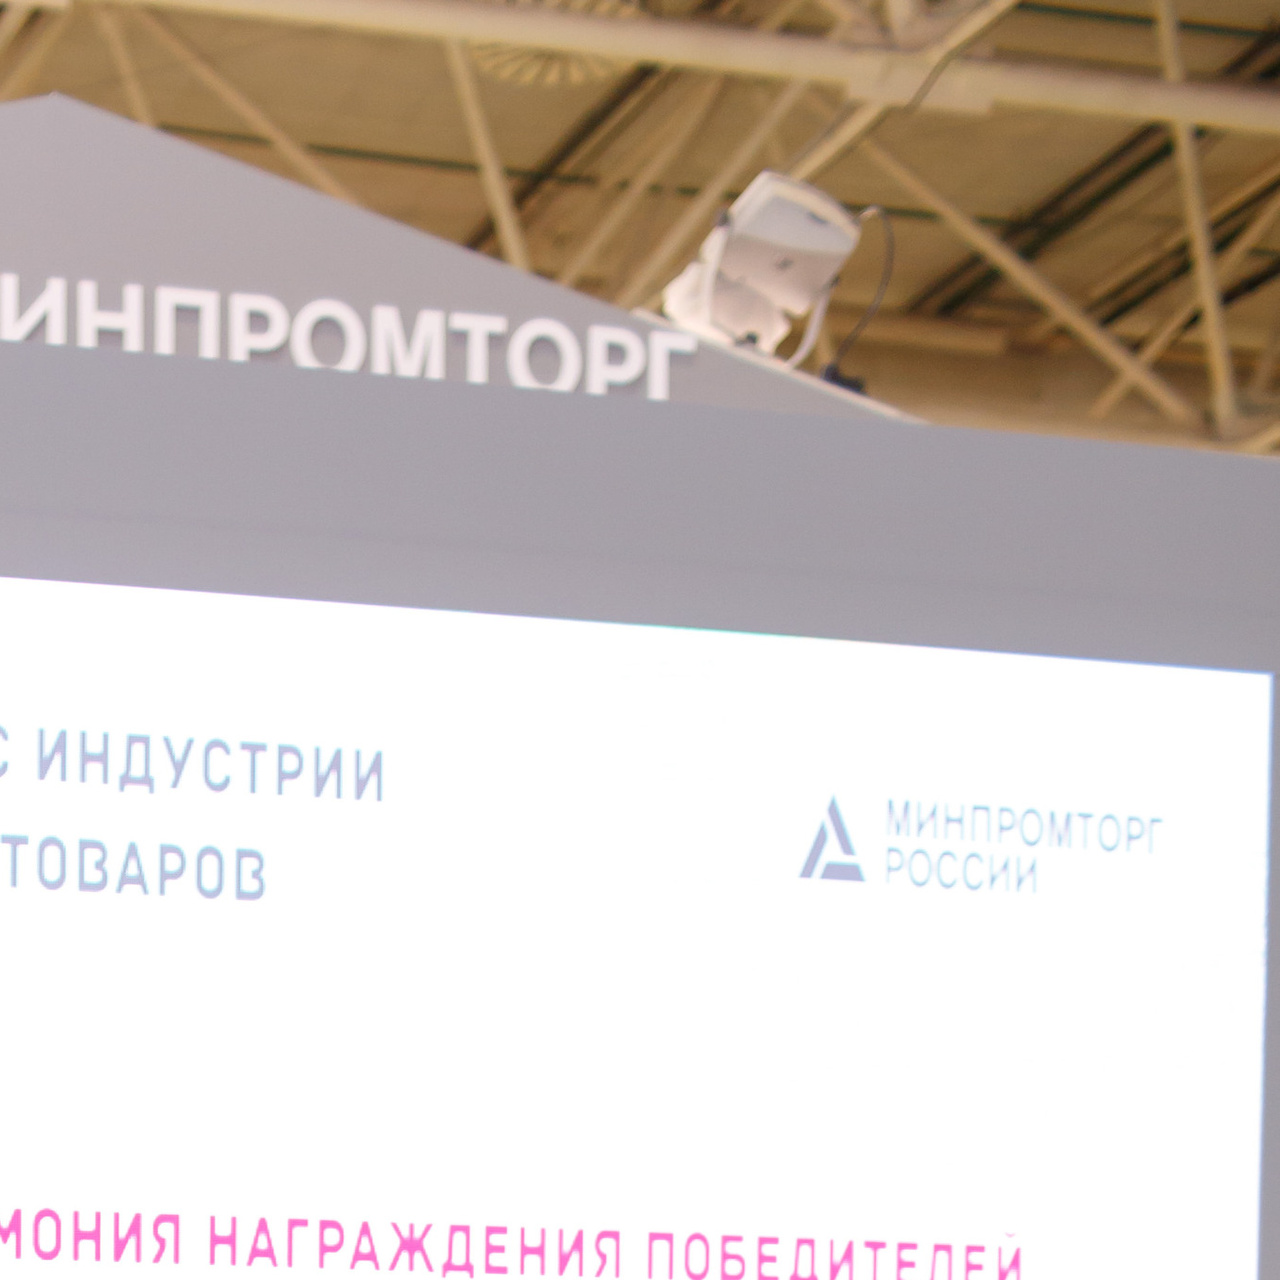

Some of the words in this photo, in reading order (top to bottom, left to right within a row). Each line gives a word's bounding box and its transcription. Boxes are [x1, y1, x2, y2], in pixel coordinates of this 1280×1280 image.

[37, 727, 384, 802] ИНДУСТРИИ
[887, 798, 1164, 854] МИНПРОМТОРГ
[0, 834, 267, 901] ТОВАРОВ
[886, 846, 1038, 893] РОССИИ
[209, 1215, 622, 1280] НАГРАЖДЕНИЯ
